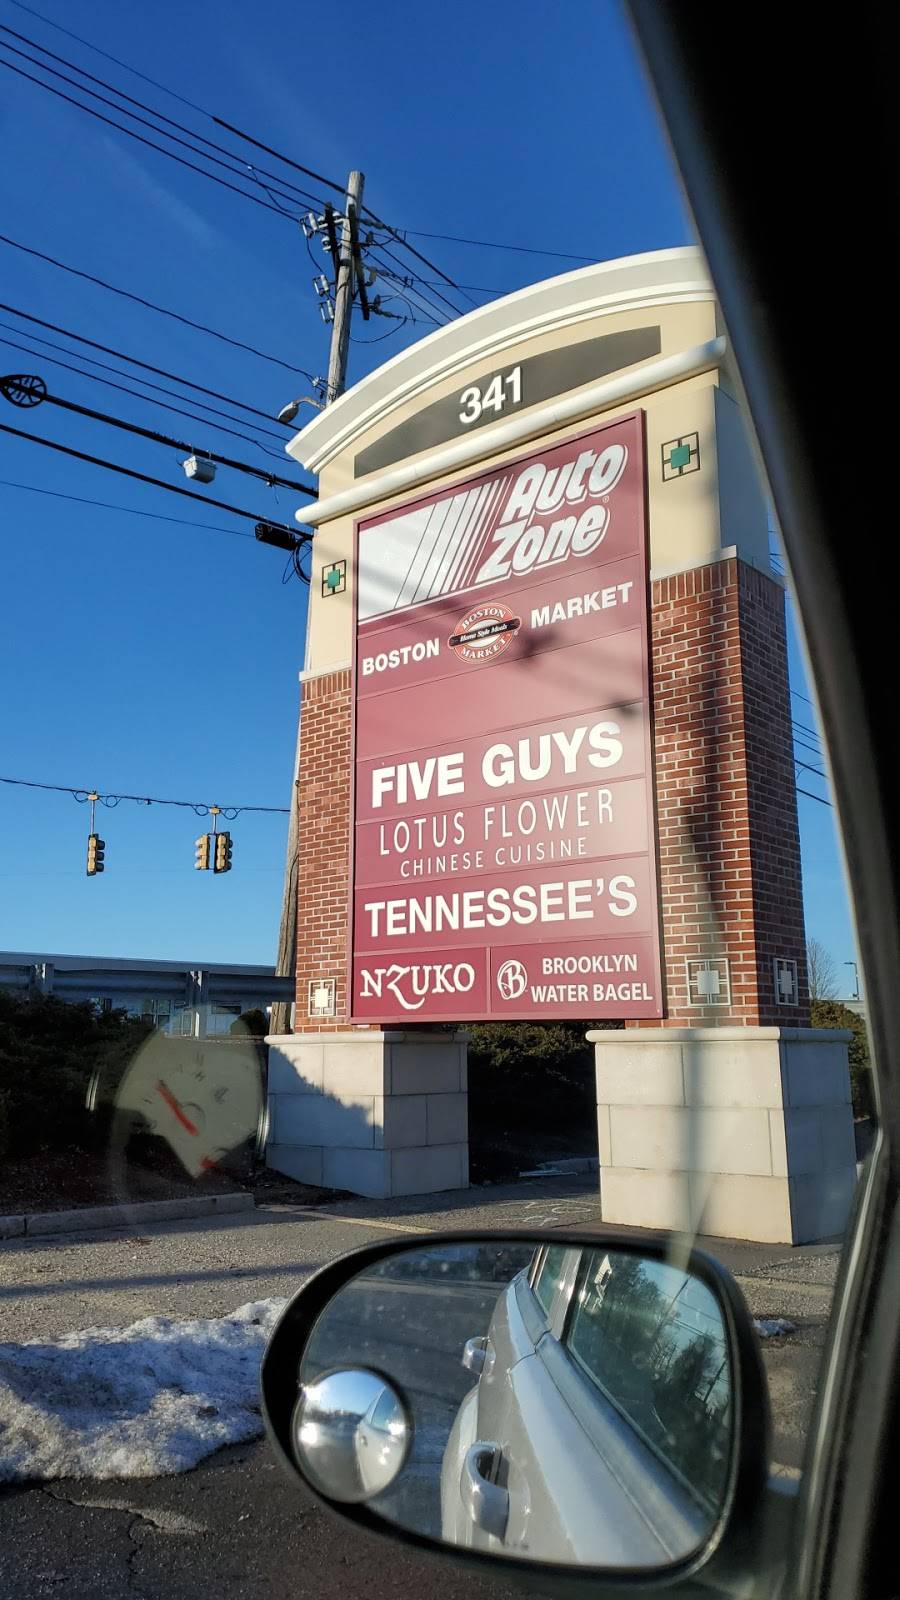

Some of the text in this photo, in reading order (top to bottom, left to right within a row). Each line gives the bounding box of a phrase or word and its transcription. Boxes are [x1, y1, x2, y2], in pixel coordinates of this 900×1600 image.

[459, 366, 524, 425] 341
[500, 444, 628, 527] Auto
[475, 504, 610, 584] Zone
[362, 581, 633, 676] BOSTON MARKET
[461, 638, 506, 659] MARKET
[462, 608, 506, 630] BOSTON
[371, 721, 624, 808] FIVE GUYS
[379, 788, 614, 856] LOTUS FLOWER
[400, 837, 587, 878] CHINESE CUISINE
[364, 875, 638, 938] TENNESSEE'S
[531, 983, 653, 1003] WATER BAGEL
[542, 954, 638, 975] BROOKLYN
